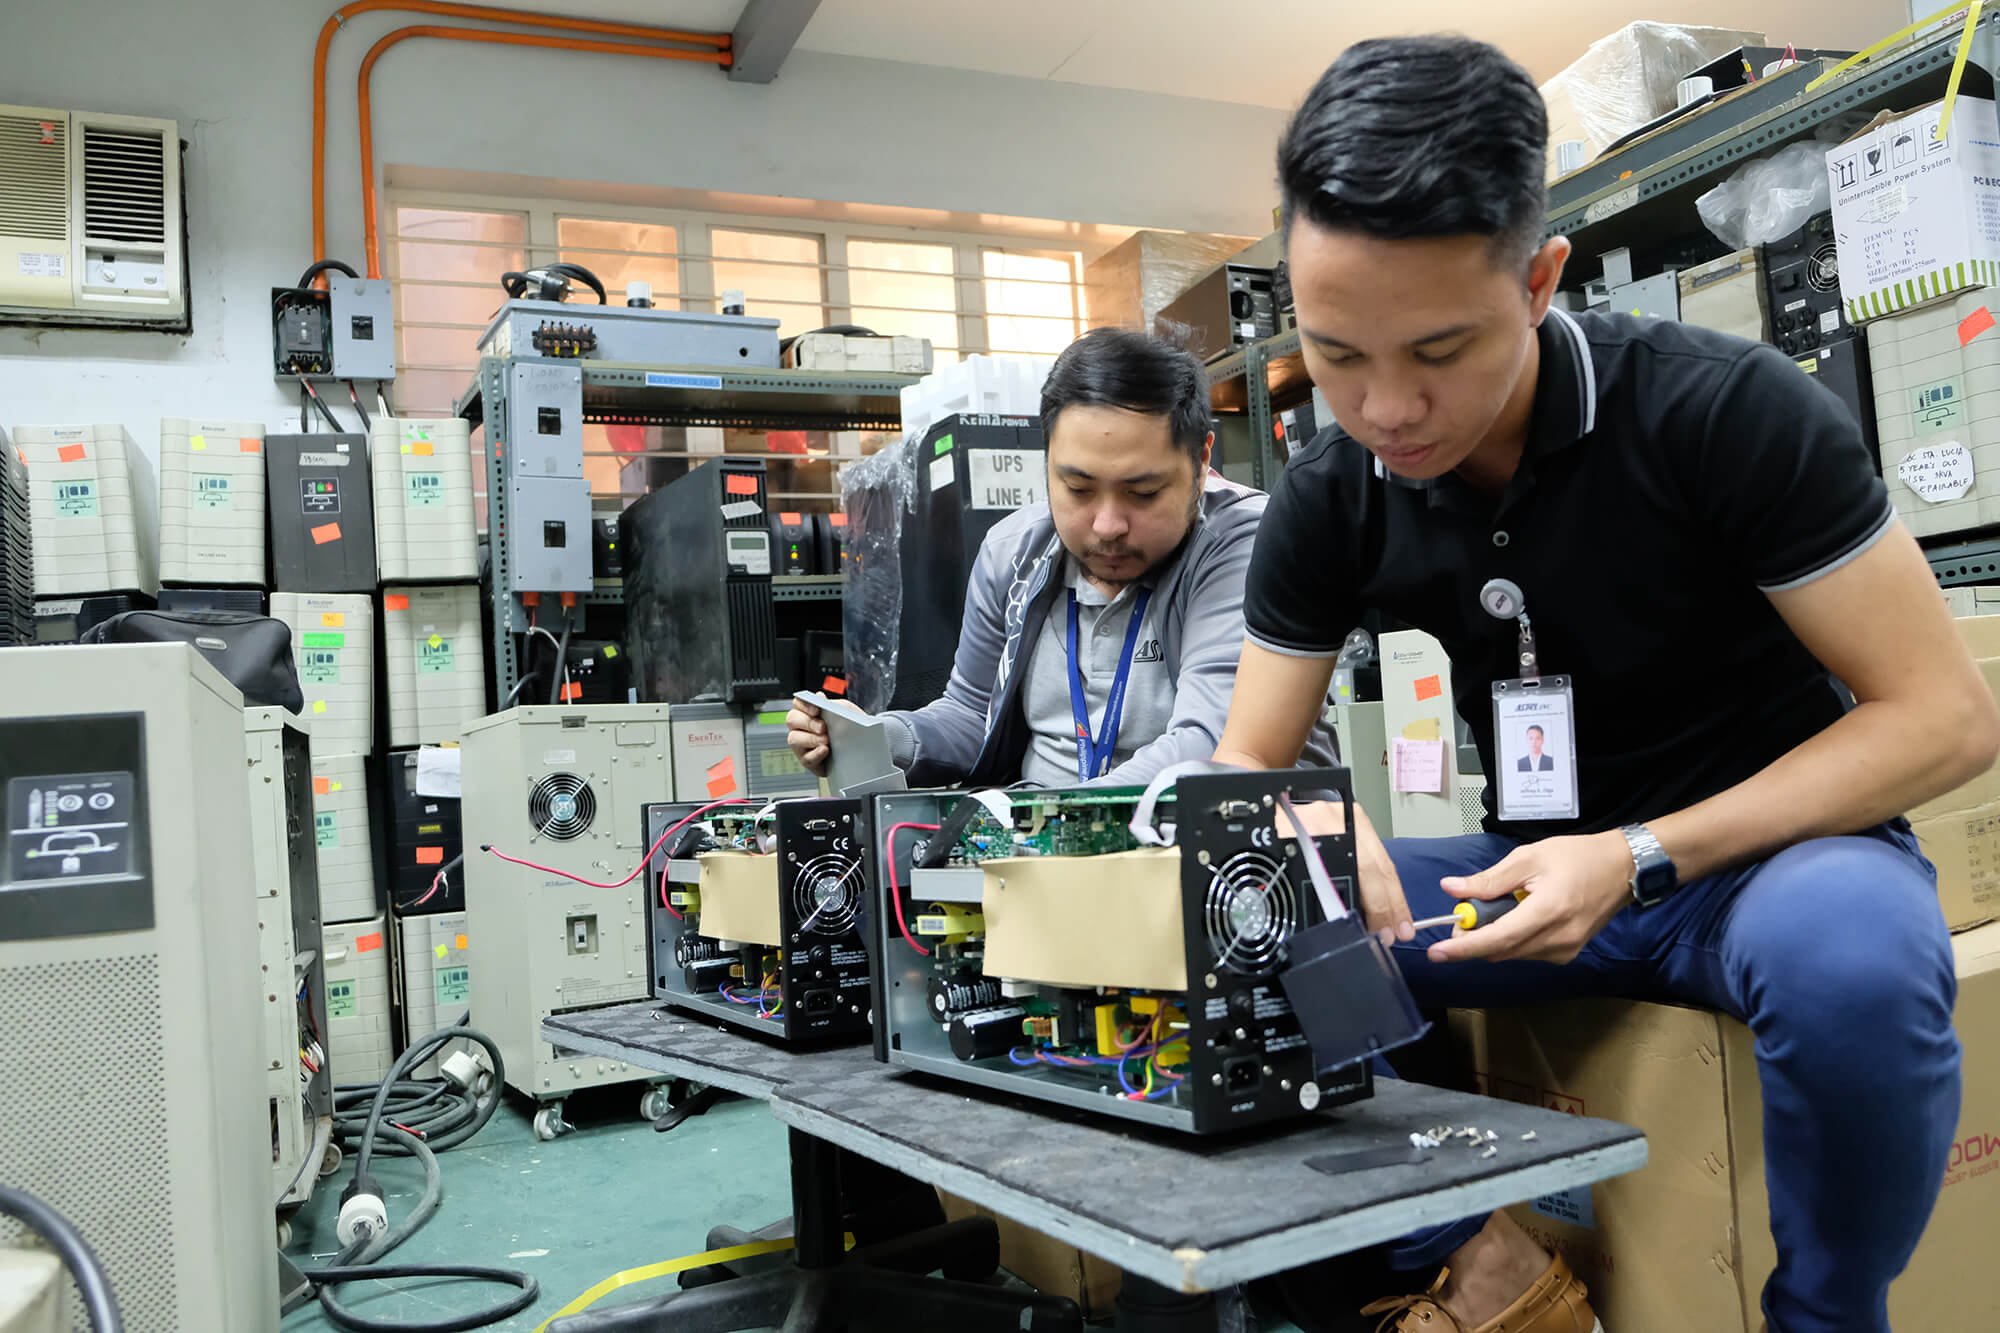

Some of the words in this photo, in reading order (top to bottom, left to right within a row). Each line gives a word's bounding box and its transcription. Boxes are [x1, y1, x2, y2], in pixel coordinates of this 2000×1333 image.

[1838, 179, 1892, 206] Uninterruptible
[1894, 170, 1918, 184] Power
[1920, 156, 1952, 173] System
[1001, 417, 1030, 427] POWER
[1941, 447, 1963, 457] LUCIA
[992, 455, 1024, 473] UPS
[986, 488, 1022, 506] LINE
[1026, 488, 1034, 504] 1
